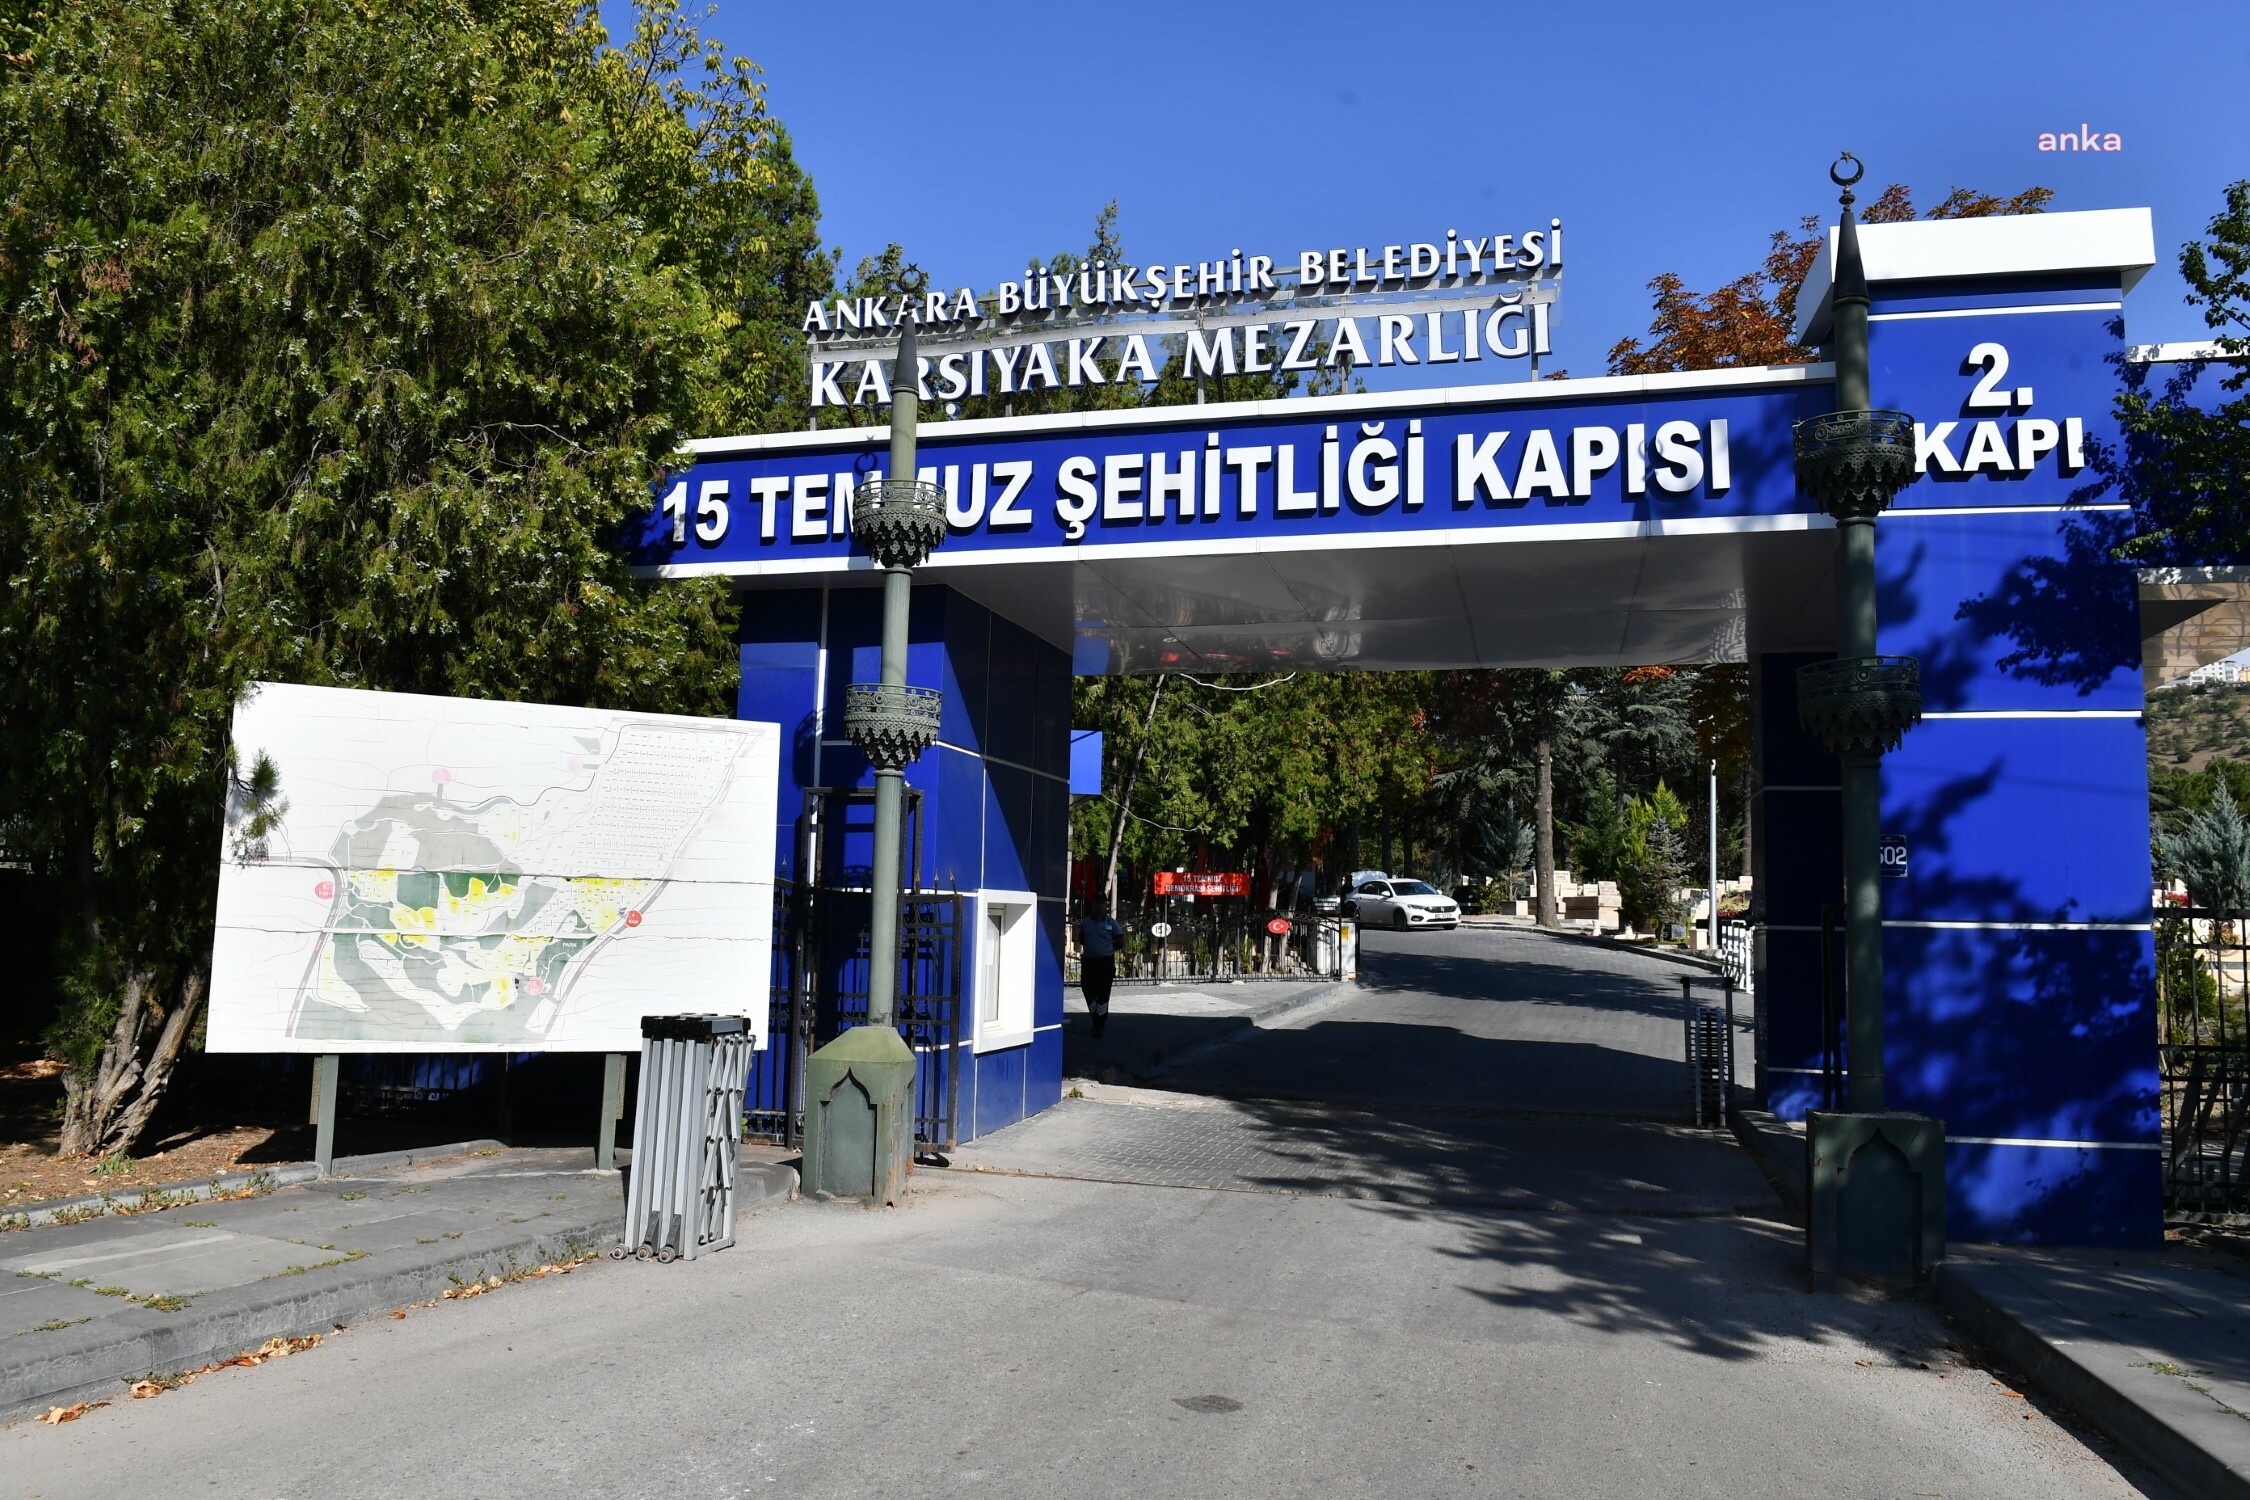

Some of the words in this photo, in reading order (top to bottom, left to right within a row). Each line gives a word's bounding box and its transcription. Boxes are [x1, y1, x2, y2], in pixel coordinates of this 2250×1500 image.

[1000, 248, 1275, 315] BÜYÜKŞEHİR
[1301, 218, 1562, 286] BELEDİYESİ
[1184, 293, 1551, 377] MEZARLIĞI
[1967, 342, 2034, 408] 2.
[662, 479, 729, 542] 15
[1056, 419, 1424, 540] ŞEHİTLİĞİ
[1457, 419, 1731, 502] KAPISI
[1914, 417, 2085, 473] KAPI
